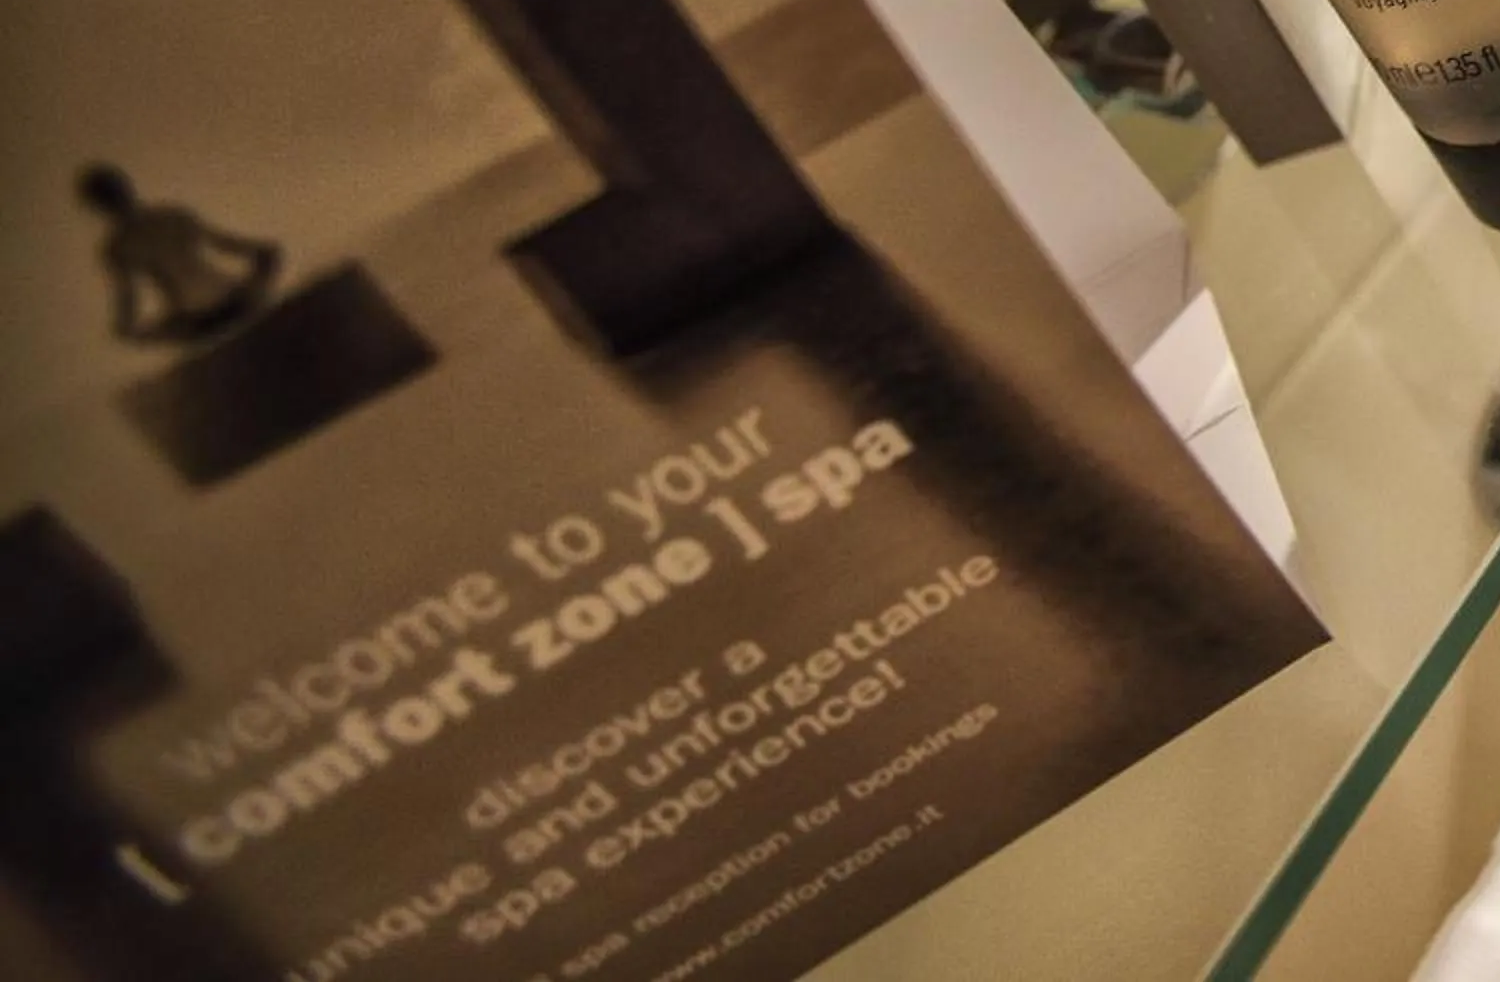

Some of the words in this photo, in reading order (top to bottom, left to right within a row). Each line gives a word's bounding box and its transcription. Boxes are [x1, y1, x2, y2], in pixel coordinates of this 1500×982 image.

[160, 570, 509, 782] welcome
[508, 516, 604, 581] to
[607, 405, 772, 543] your
[176, 646, 515, 862] comfort
[510, 535, 713, 671] zone
[760, 417, 915, 524] spa
[465, 666, 704, 830] discover
[722, 638, 768, 676] a
[503, 779, 618, 864] and
[625, 554, 998, 788] unforgettable
[459, 867, 578, 944] spa
[585, 658, 906, 870] experience!
[559, 932, 630, 978] spa
[632, 829, 792, 932] reception
[792, 794, 843, 834] for
[846, 703, 998, 801] bookings
